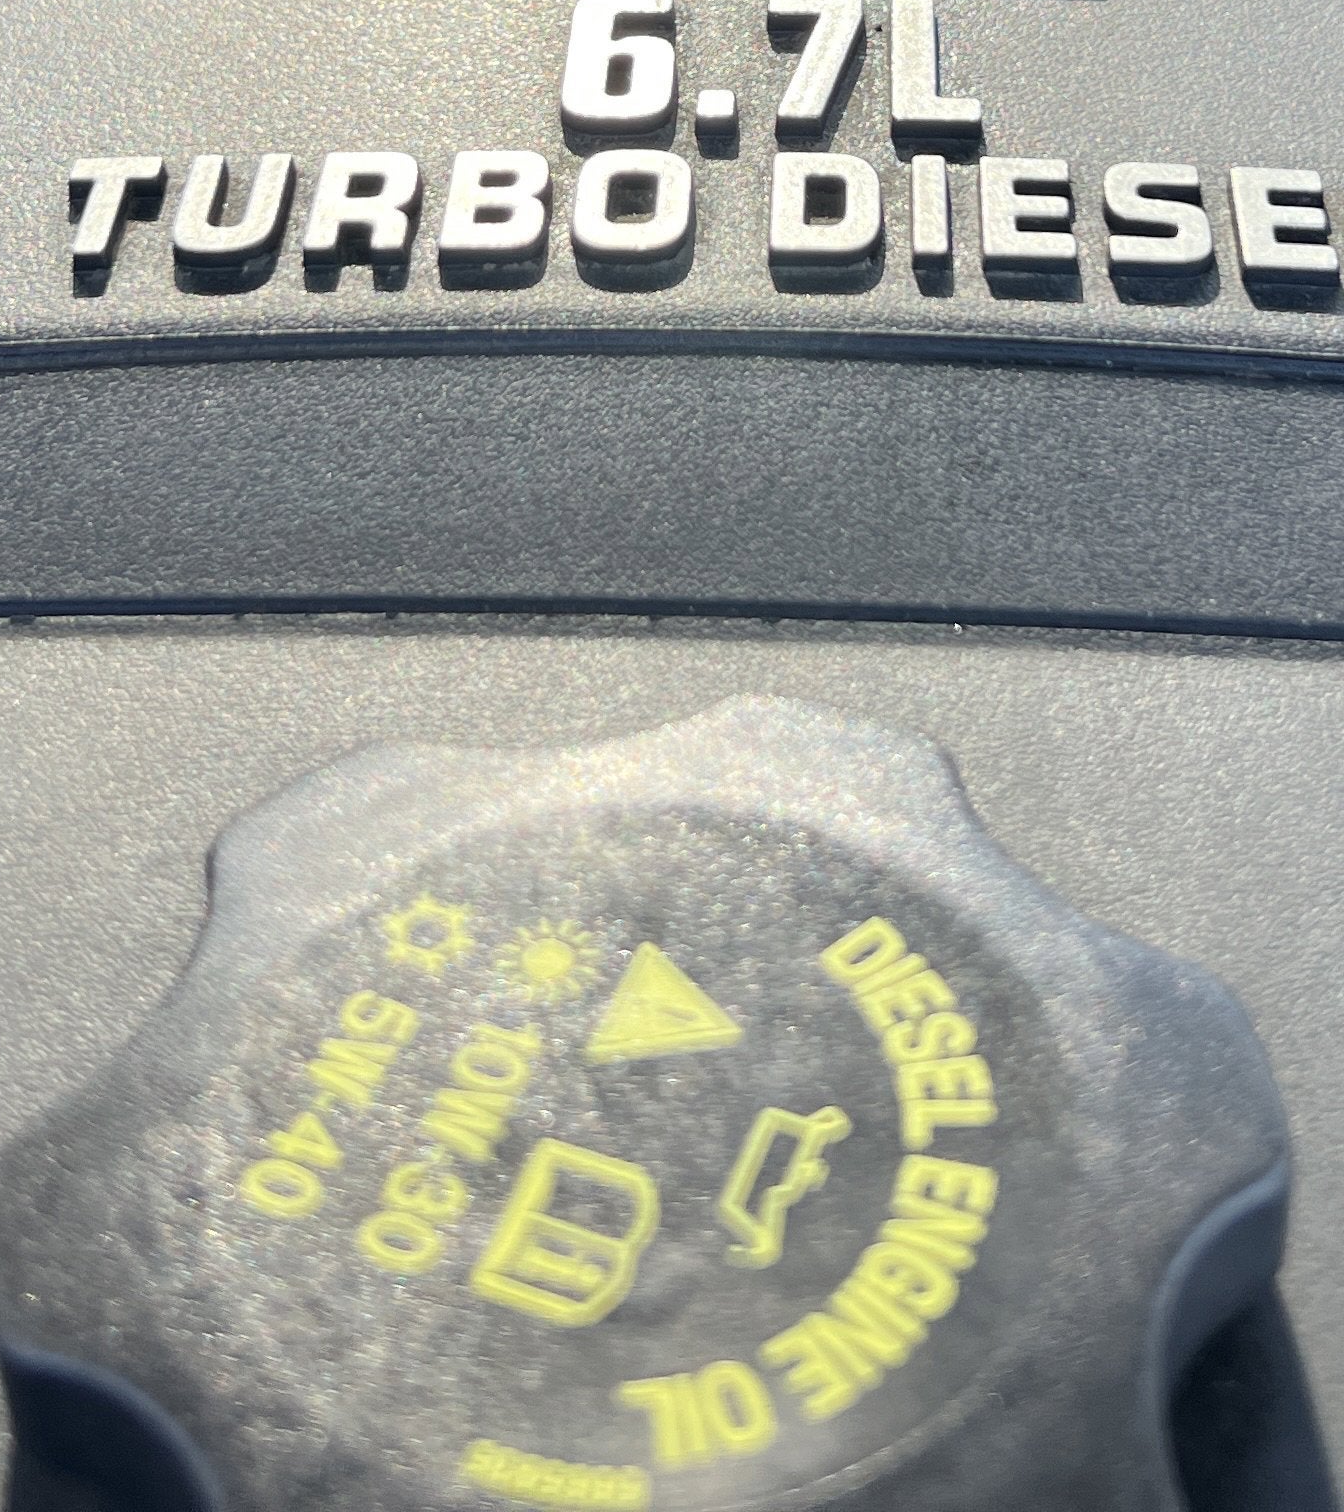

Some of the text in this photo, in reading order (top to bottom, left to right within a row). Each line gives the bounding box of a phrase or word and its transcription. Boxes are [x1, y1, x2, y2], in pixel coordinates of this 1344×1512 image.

[68, 148, 698, 292] TURBO
[242, 990, 420, 1218] 5W-40
[358, 1022, 542, 1272] 10W-30
[616, 916, 998, 1466] DIESEL ENGINE OIL
